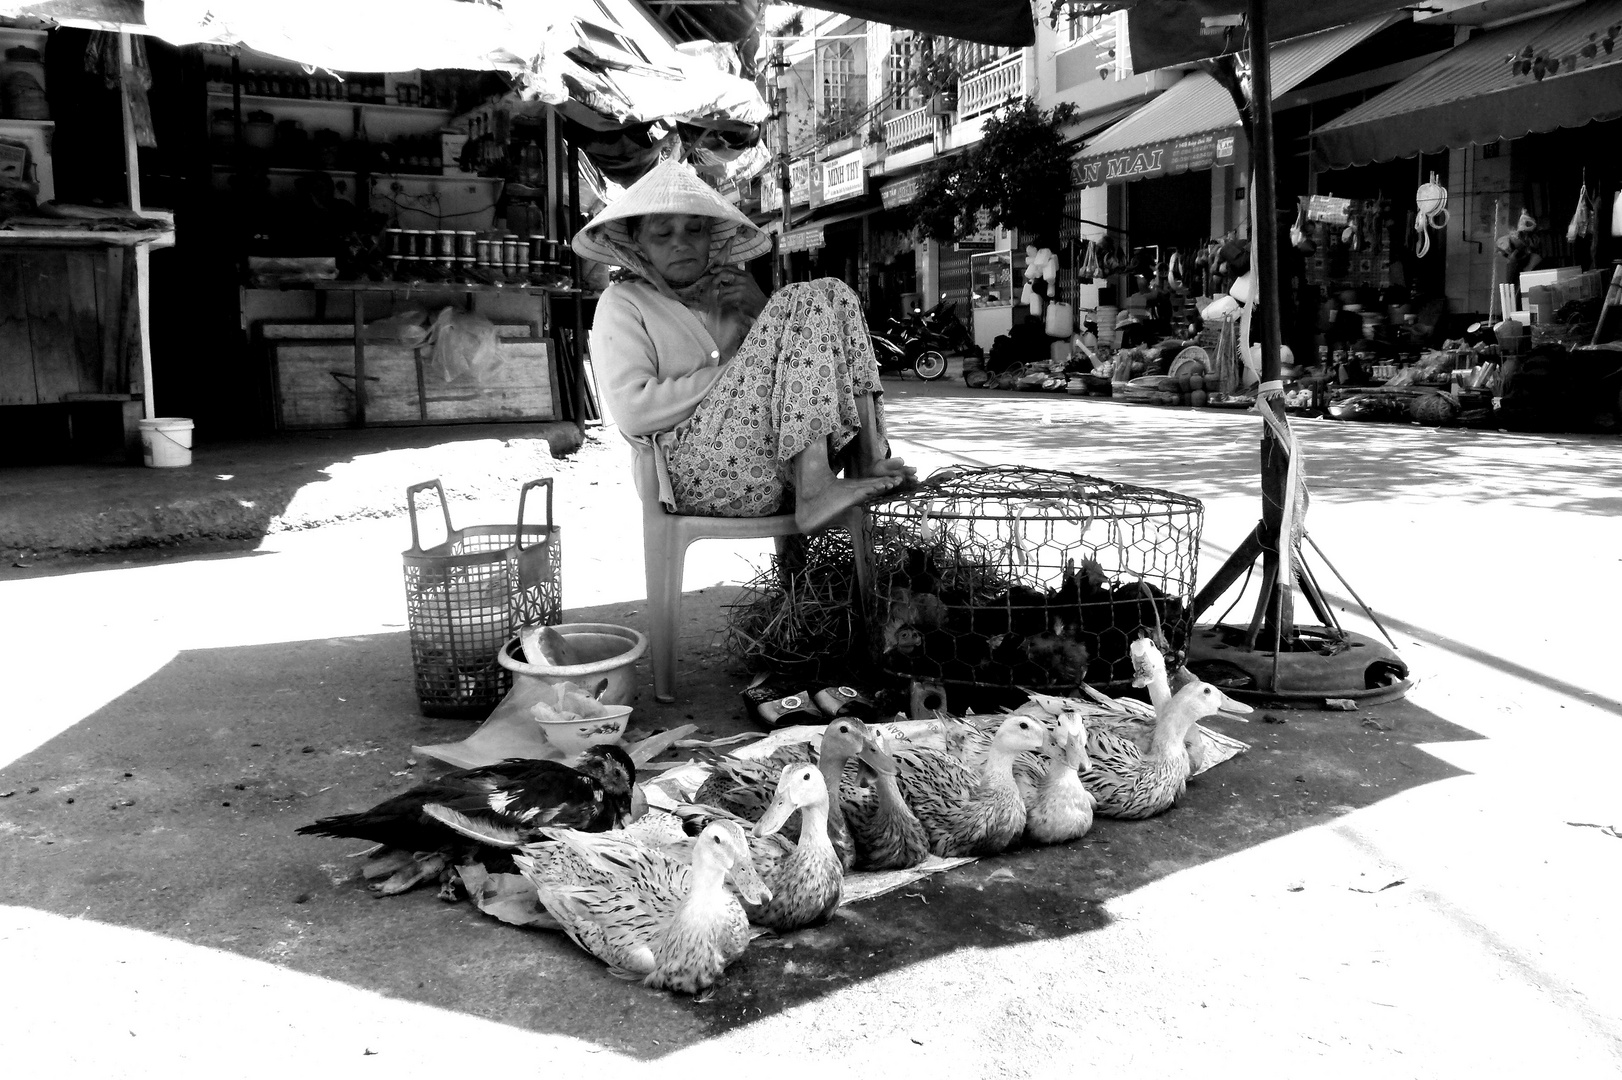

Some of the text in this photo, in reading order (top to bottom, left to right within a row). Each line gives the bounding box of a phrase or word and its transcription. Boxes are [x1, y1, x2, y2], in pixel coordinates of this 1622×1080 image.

[827, 165, 845, 188] MINH
[846, 159, 860, 182] THY
[1106, 149, 1164, 179] MAI
